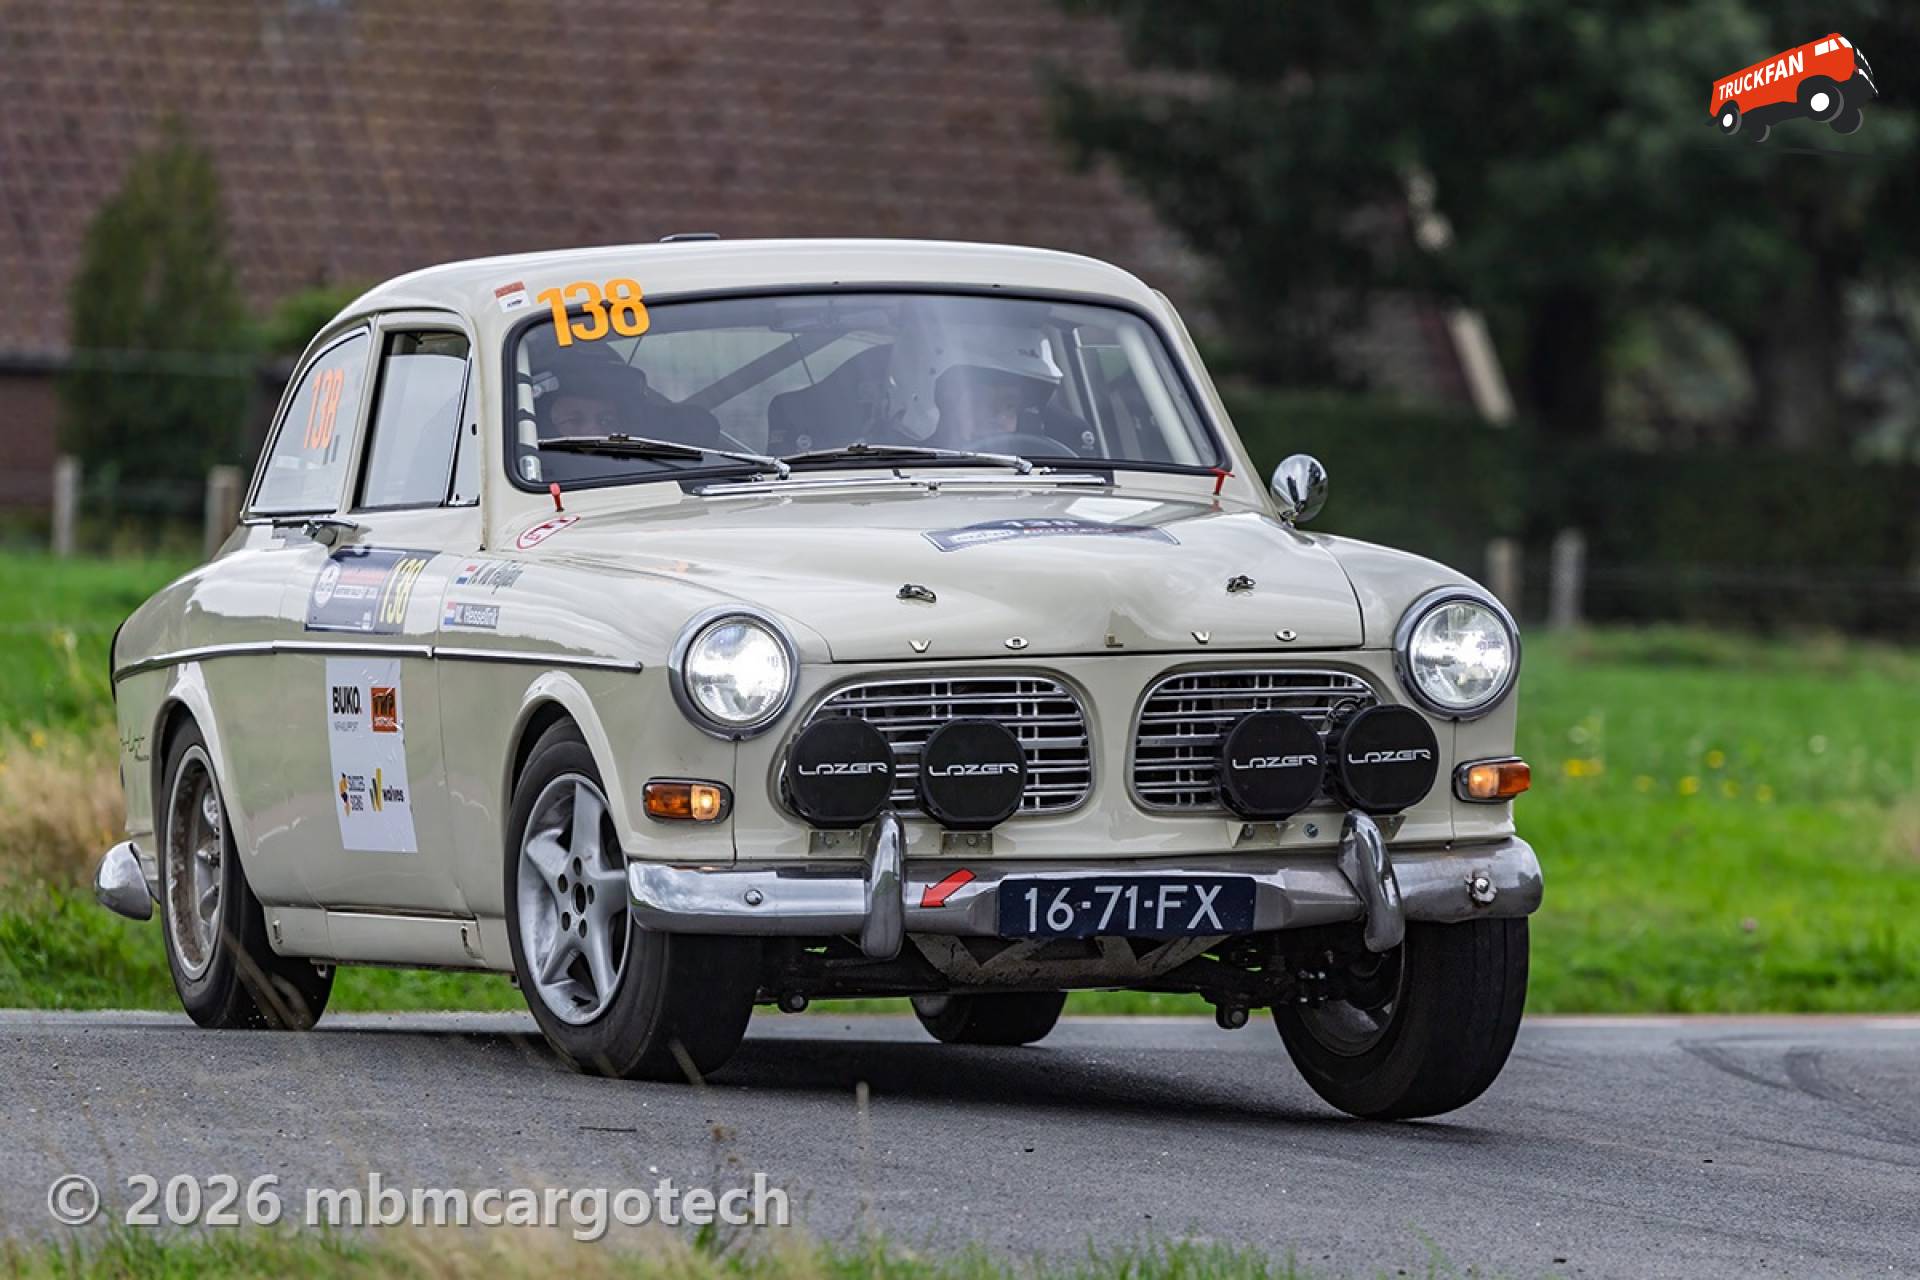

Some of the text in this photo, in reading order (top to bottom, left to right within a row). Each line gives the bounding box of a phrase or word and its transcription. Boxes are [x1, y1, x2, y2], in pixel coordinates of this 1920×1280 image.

[536, 278, 650, 347] 138
[379, 558, 427, 624] 138
[1232, 754, 1318, 770] LAZER
[1348, 748, 1432, 764] LAZER
[798, 761, 888, 775] LAZER
[928, 762, 1019, 777] LAZER
[1024, 884, 1224, 933] 16-71-FX
